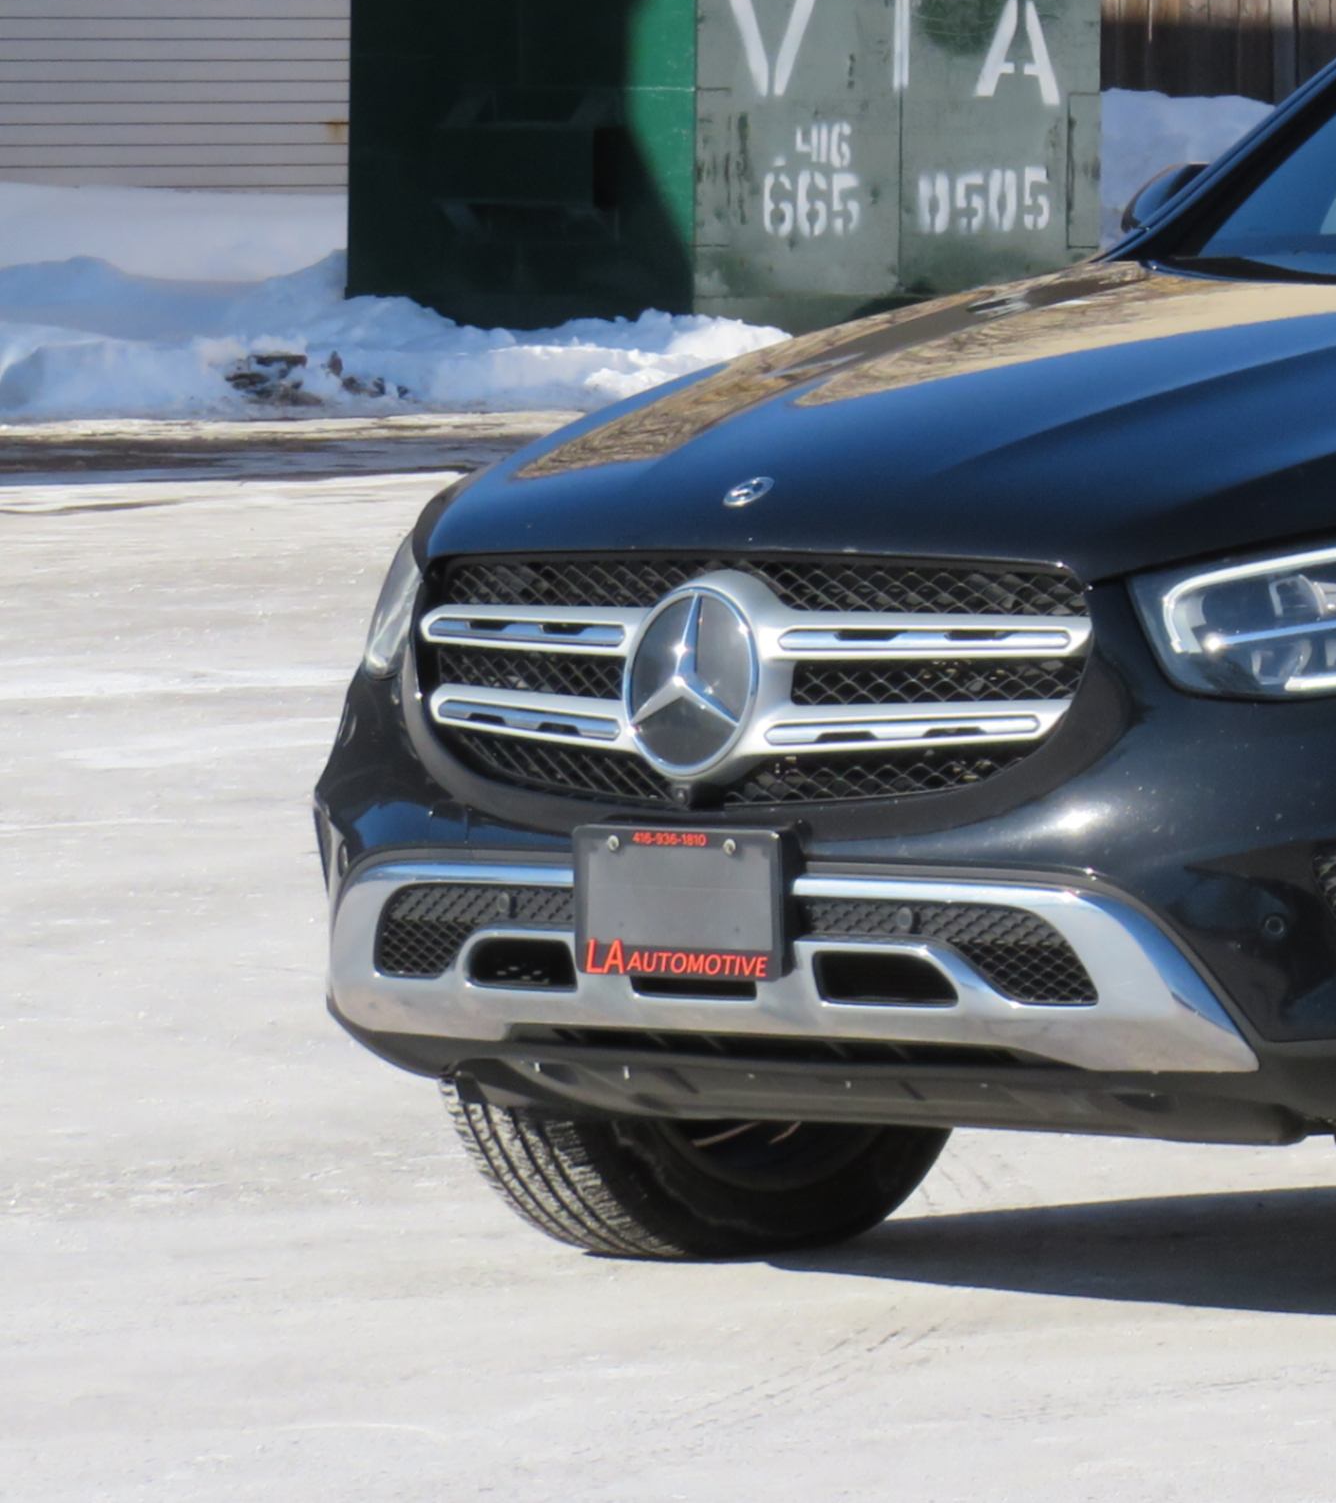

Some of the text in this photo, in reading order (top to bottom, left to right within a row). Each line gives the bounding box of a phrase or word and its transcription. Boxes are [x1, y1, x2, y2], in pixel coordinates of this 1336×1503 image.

[796, 121, 852, 168] 416
[763, 166, 1050, 237] 665 0505
[586, 938, 768, 977] LA AUTOMOTIVE
